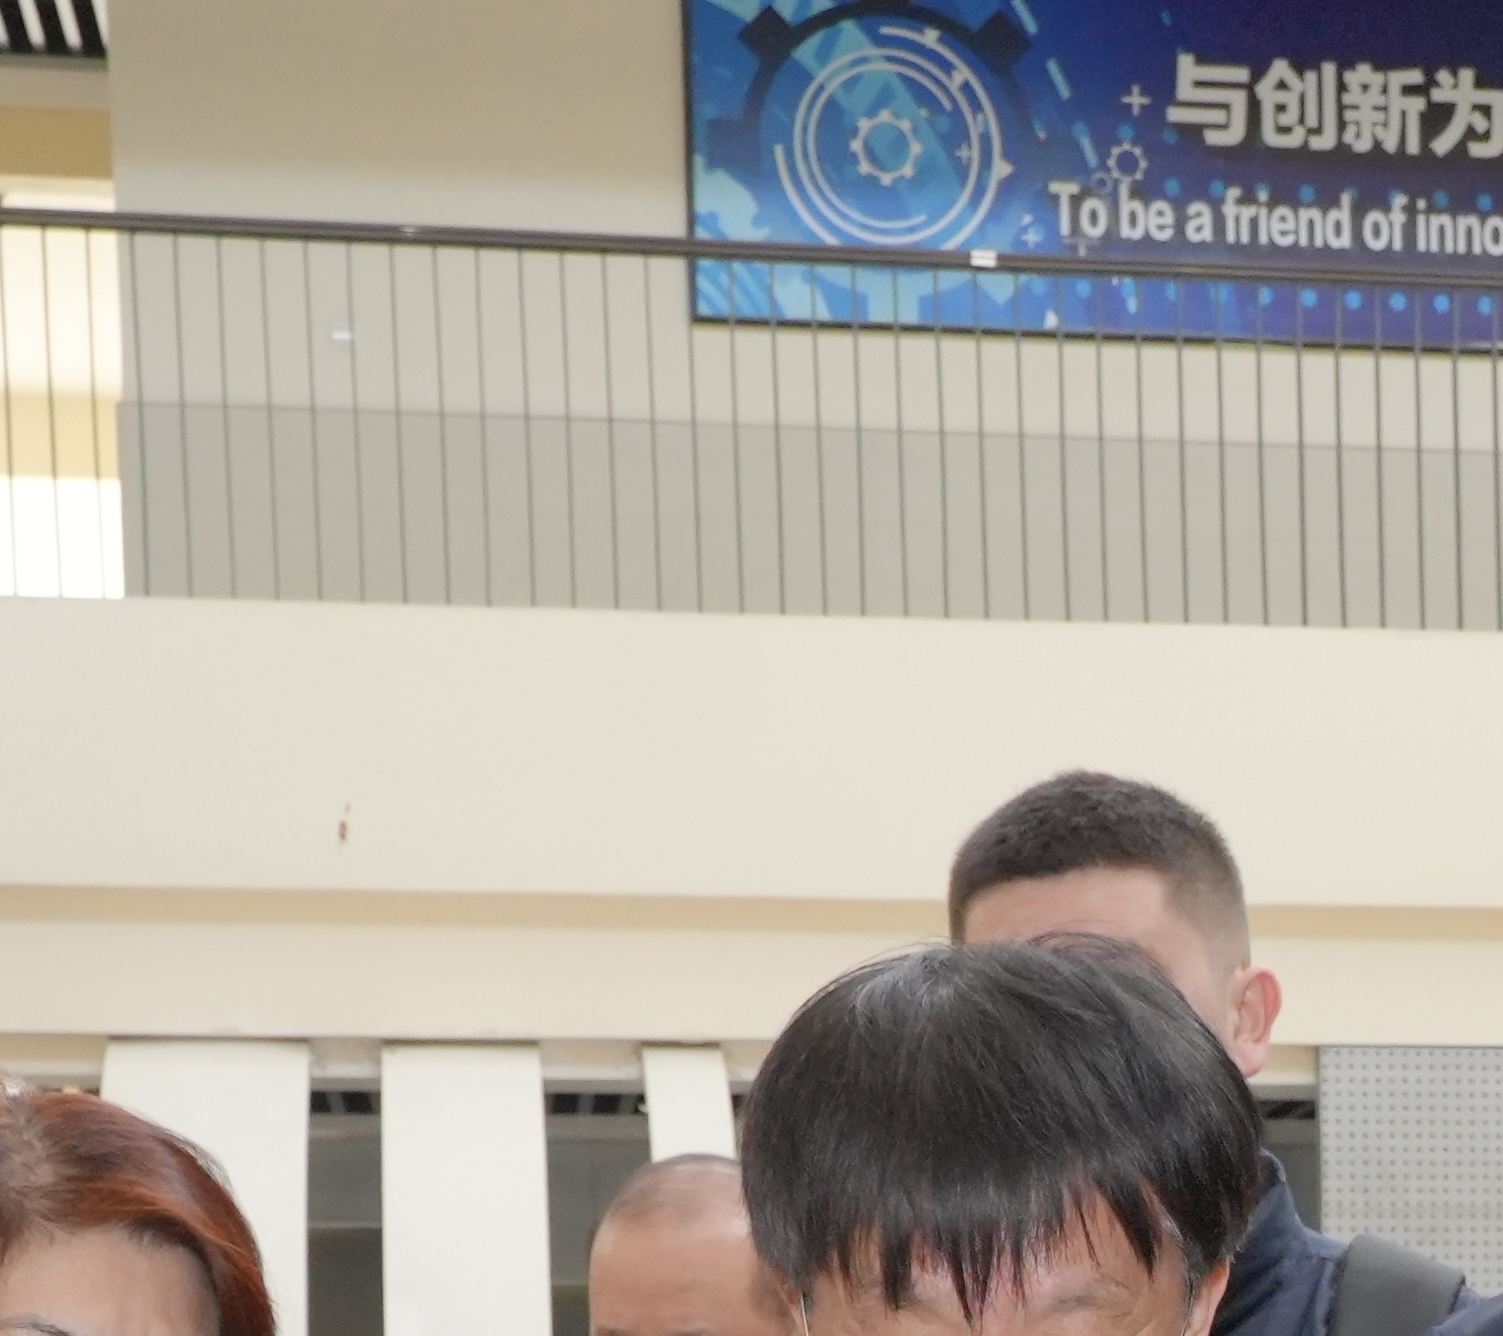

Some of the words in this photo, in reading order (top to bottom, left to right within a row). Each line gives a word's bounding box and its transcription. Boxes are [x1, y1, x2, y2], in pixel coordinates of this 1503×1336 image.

[1049, 181, 1106, 239] To
[1118, 182, 1174, 241] be
[1185, 203, 1214, 243] a
[1223, 186, 1351, 250] friend
[1362, 190, 1406, 251] of
